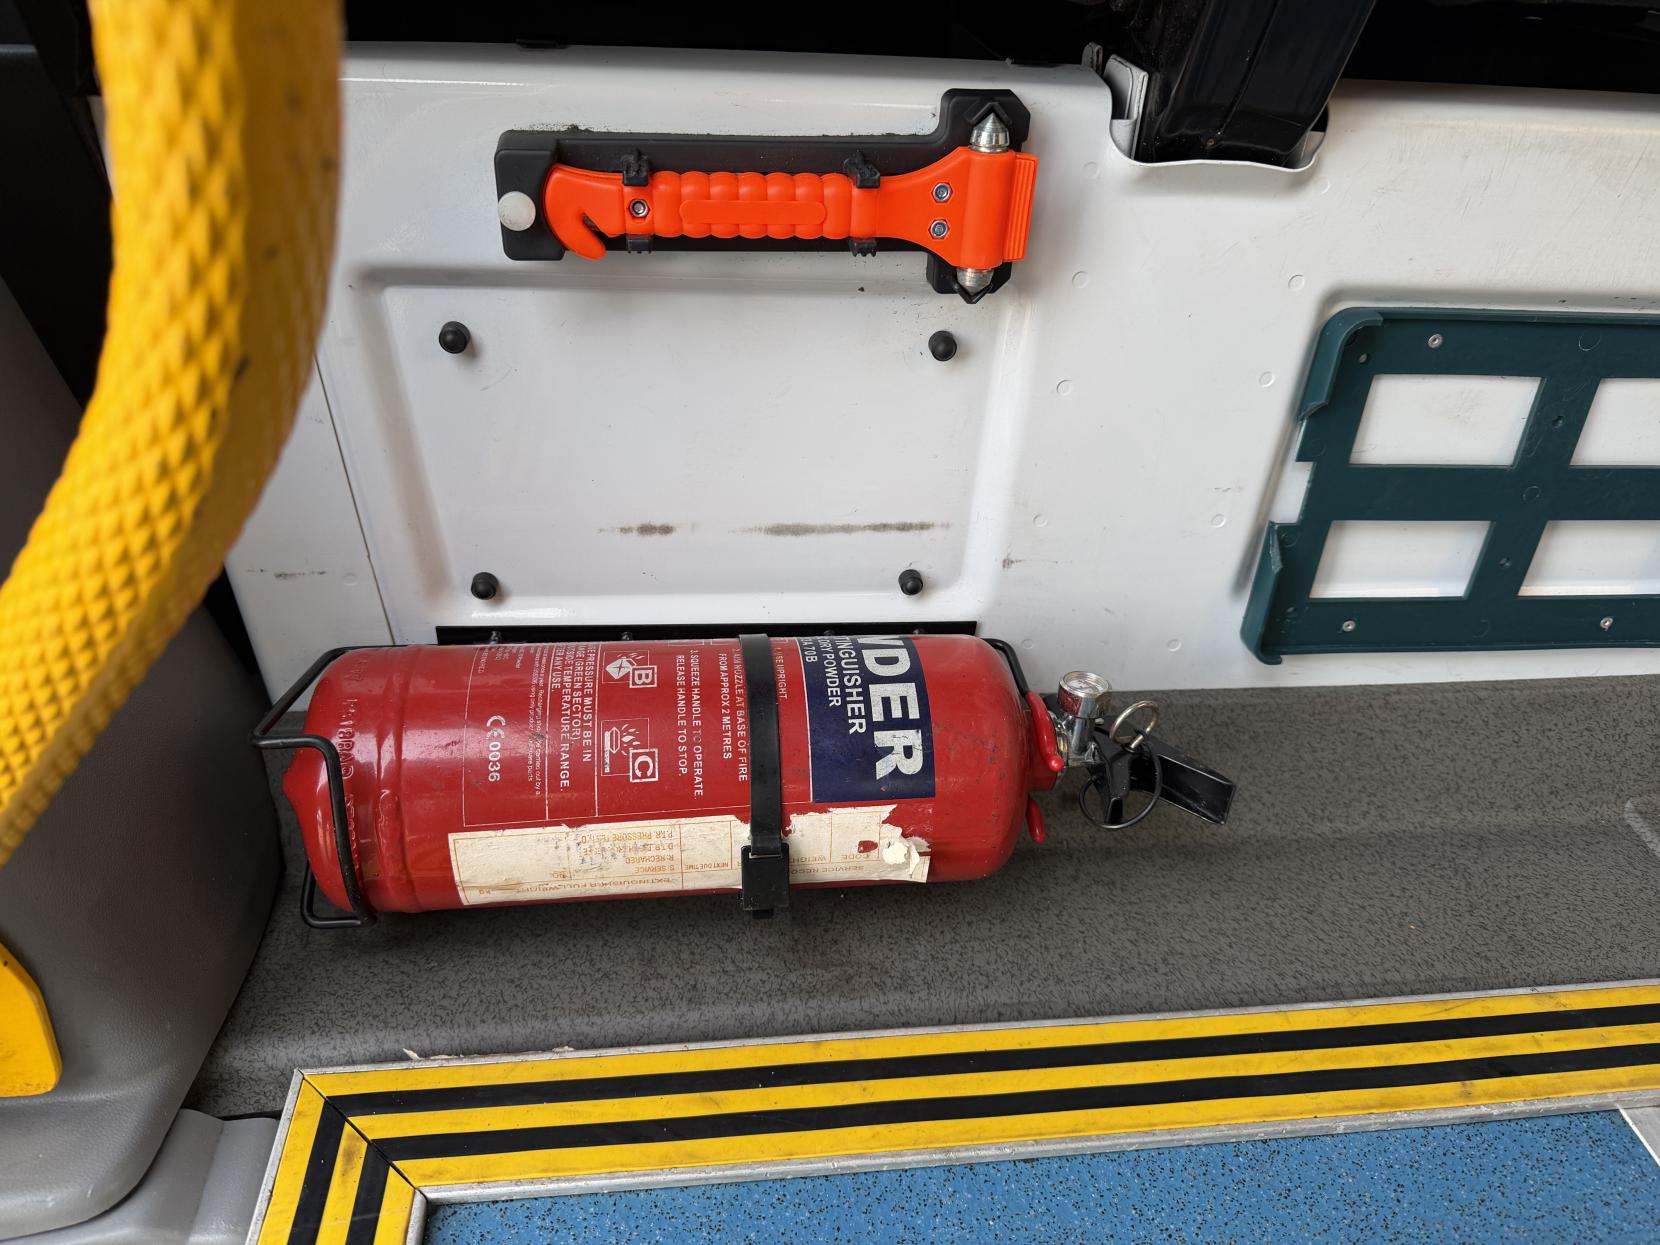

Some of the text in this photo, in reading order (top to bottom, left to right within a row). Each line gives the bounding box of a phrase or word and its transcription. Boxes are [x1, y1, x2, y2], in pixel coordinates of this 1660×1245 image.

[804, 646, 818, 663] 70B
[817, 640, 832, 652] DRY
[553, 656, 562, 670] ANY
[691, 654, 700, 686] SQUEEZE
[719, 653, 729, 671] FROM
[734, 653, 742, 665] AIM
[551, 672, 561, 692] USE.
[573, 659, 583, 689] (GREEN
[584, 653, 594, 695] PRESSURE
[634, 670, 652, 684] B
[734, 665, 745, 695] NOZZLE
[822, 653, 842, 707] POWDER
[720, 672, 730, 706] APPROX
[560, 666, 572, 741] TEMPERATURE
[583, 697, 592, 727] MUST
[692, 688, 701, 726] HANDLE
[736, 696, 745, 707] AT
[570, 691, 582, 744] SECTOR).
[676, 655, 688, 777] RELEASE HANDLE TO STOP.
[737, 710, 746, 737] BASE
[582, 731, 591, 746] BE
[693, 730, 701, 742] TO
[722, 716, 732, 759] METRES
[738, 740, 746, 754] OF
[488, 741, 500, 782] 0036
[582, 749, 591, 762] IN
[634, 755, 653, 777] C
[560, 744, 569, 792] RANGE.
[694, 745, 703, 800] OPERATE.
[739, 758, 747, 782] FIRE
[534, 782, 541, 790] by
[700, 862, 712, 870] DUE
[790, 855, 826, 863] WEIGH
[558, 882, 587, 890] FULL
